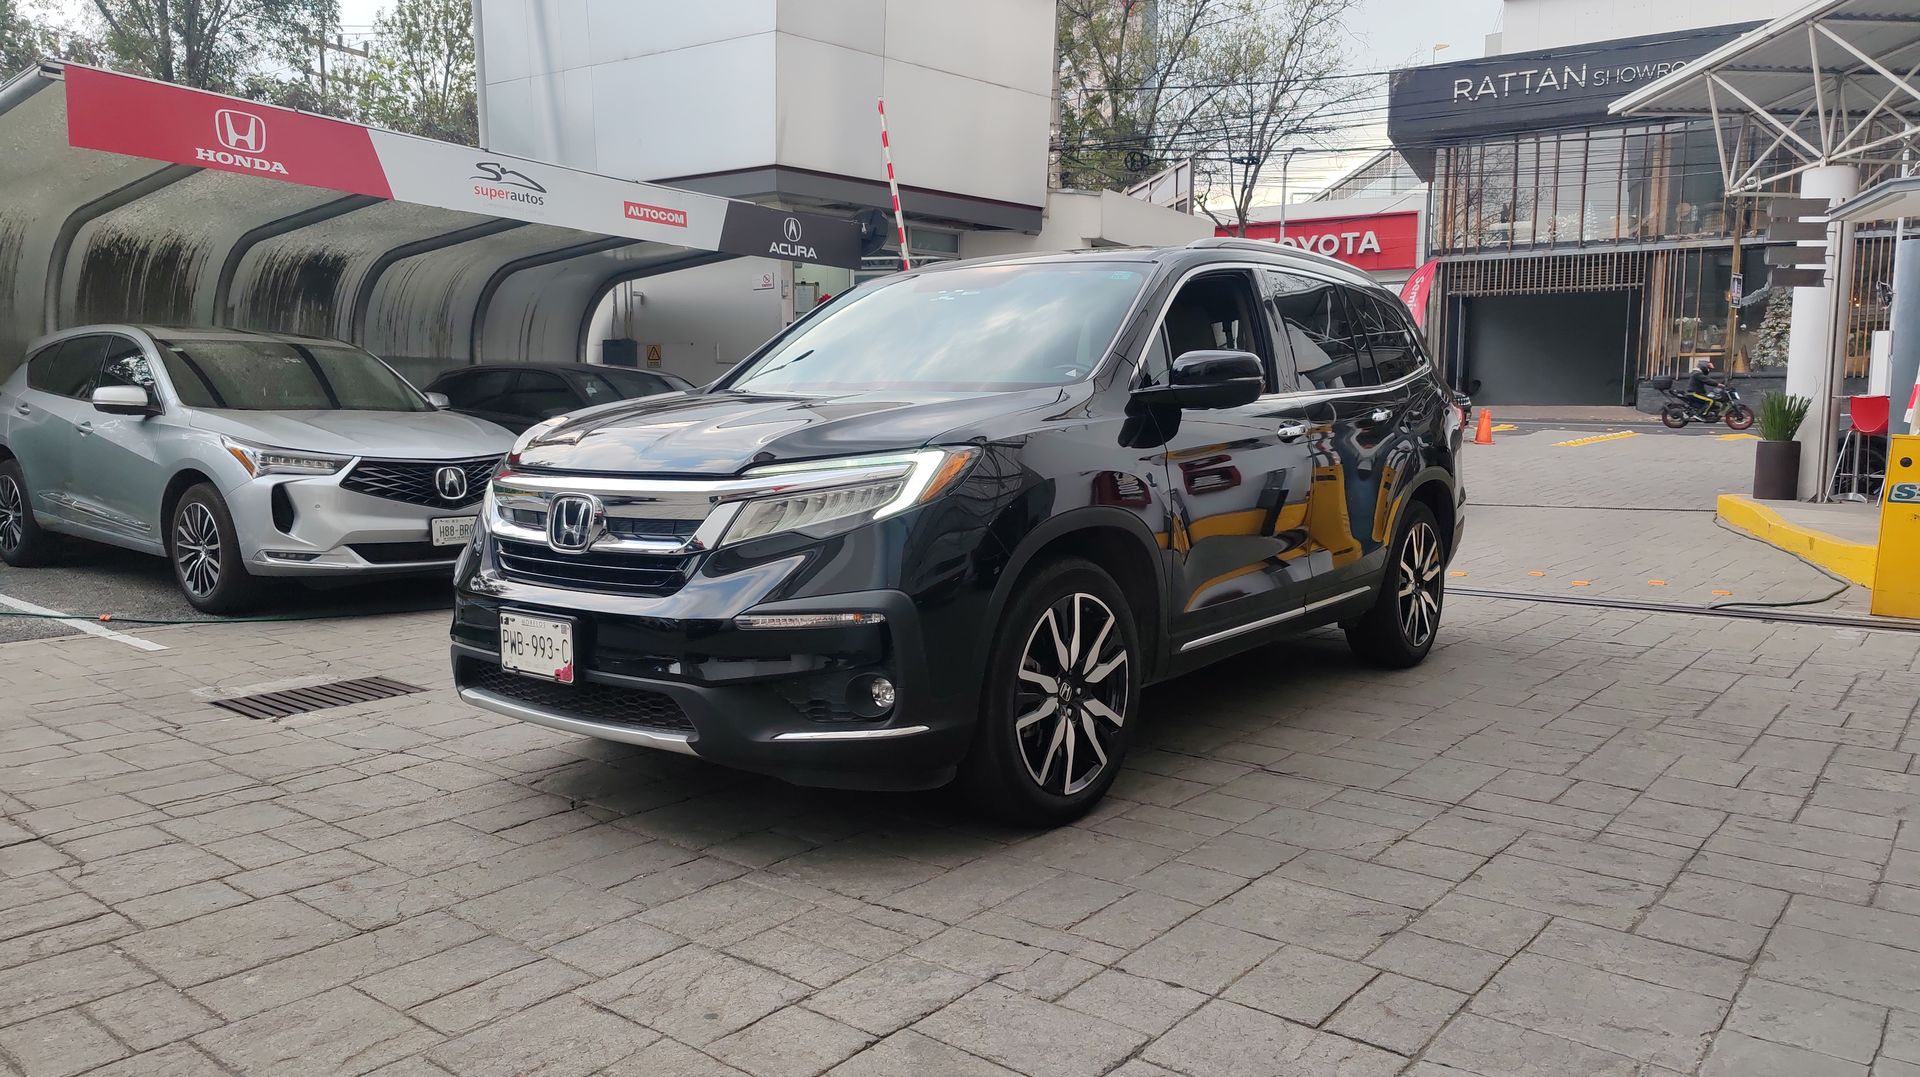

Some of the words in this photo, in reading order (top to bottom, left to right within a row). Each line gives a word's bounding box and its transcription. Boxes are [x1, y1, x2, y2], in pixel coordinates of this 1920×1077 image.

[1453, 63, 1587, 103] RATTAN
[195, 147, 289, 175] HONDA
[474, 185, 544, 206] superautos
[628, 205, 685, 225] AUTOCOM
[769, 241, 818, 259] ACURA
[502, 628, 569, 664] PWB-993-C
